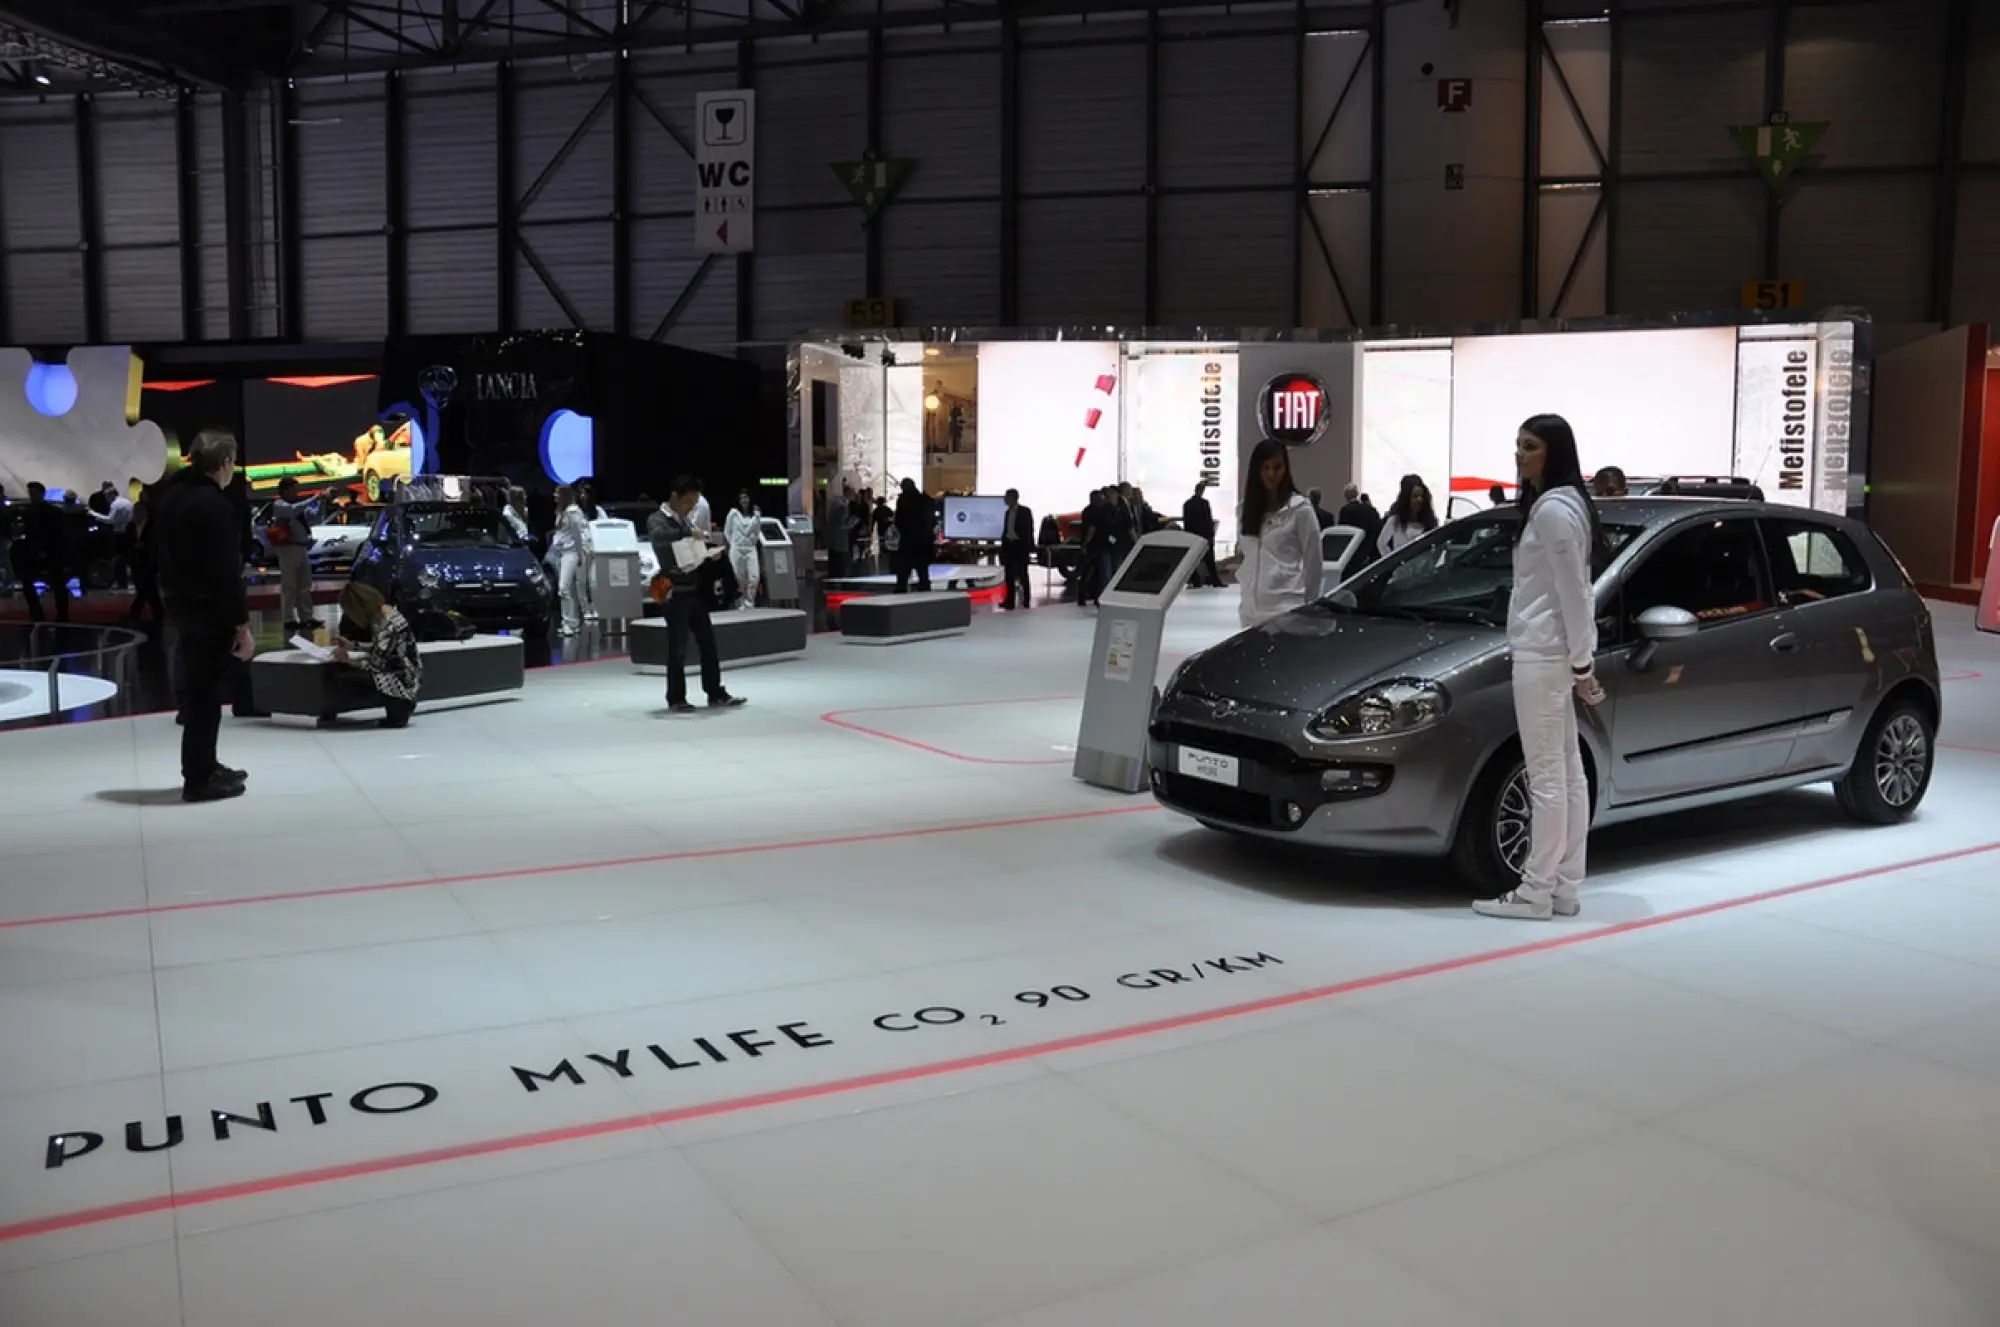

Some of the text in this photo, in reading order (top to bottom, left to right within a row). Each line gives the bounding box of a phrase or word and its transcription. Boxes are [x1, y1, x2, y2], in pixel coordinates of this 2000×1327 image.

[1448, 80, 1465, 105] F
[698, 160, 750, 188] WC
[1757, 283, 1790, 309] 51
[475, 371, 538, 400] LANCIA
[1200, 361, 1222, 487] Mefistofele
[1272, 391, 1320, 430] FIAT
[1778, 350, 1808, 490] Mefistofele
[45, 1083, 438, 1170] PUNTO
[510, 1022, 834, 1092] MYLIFE
[1015, 985, 1091, 1009] 90
[1116, 951, 1283, 990] GR/KM
